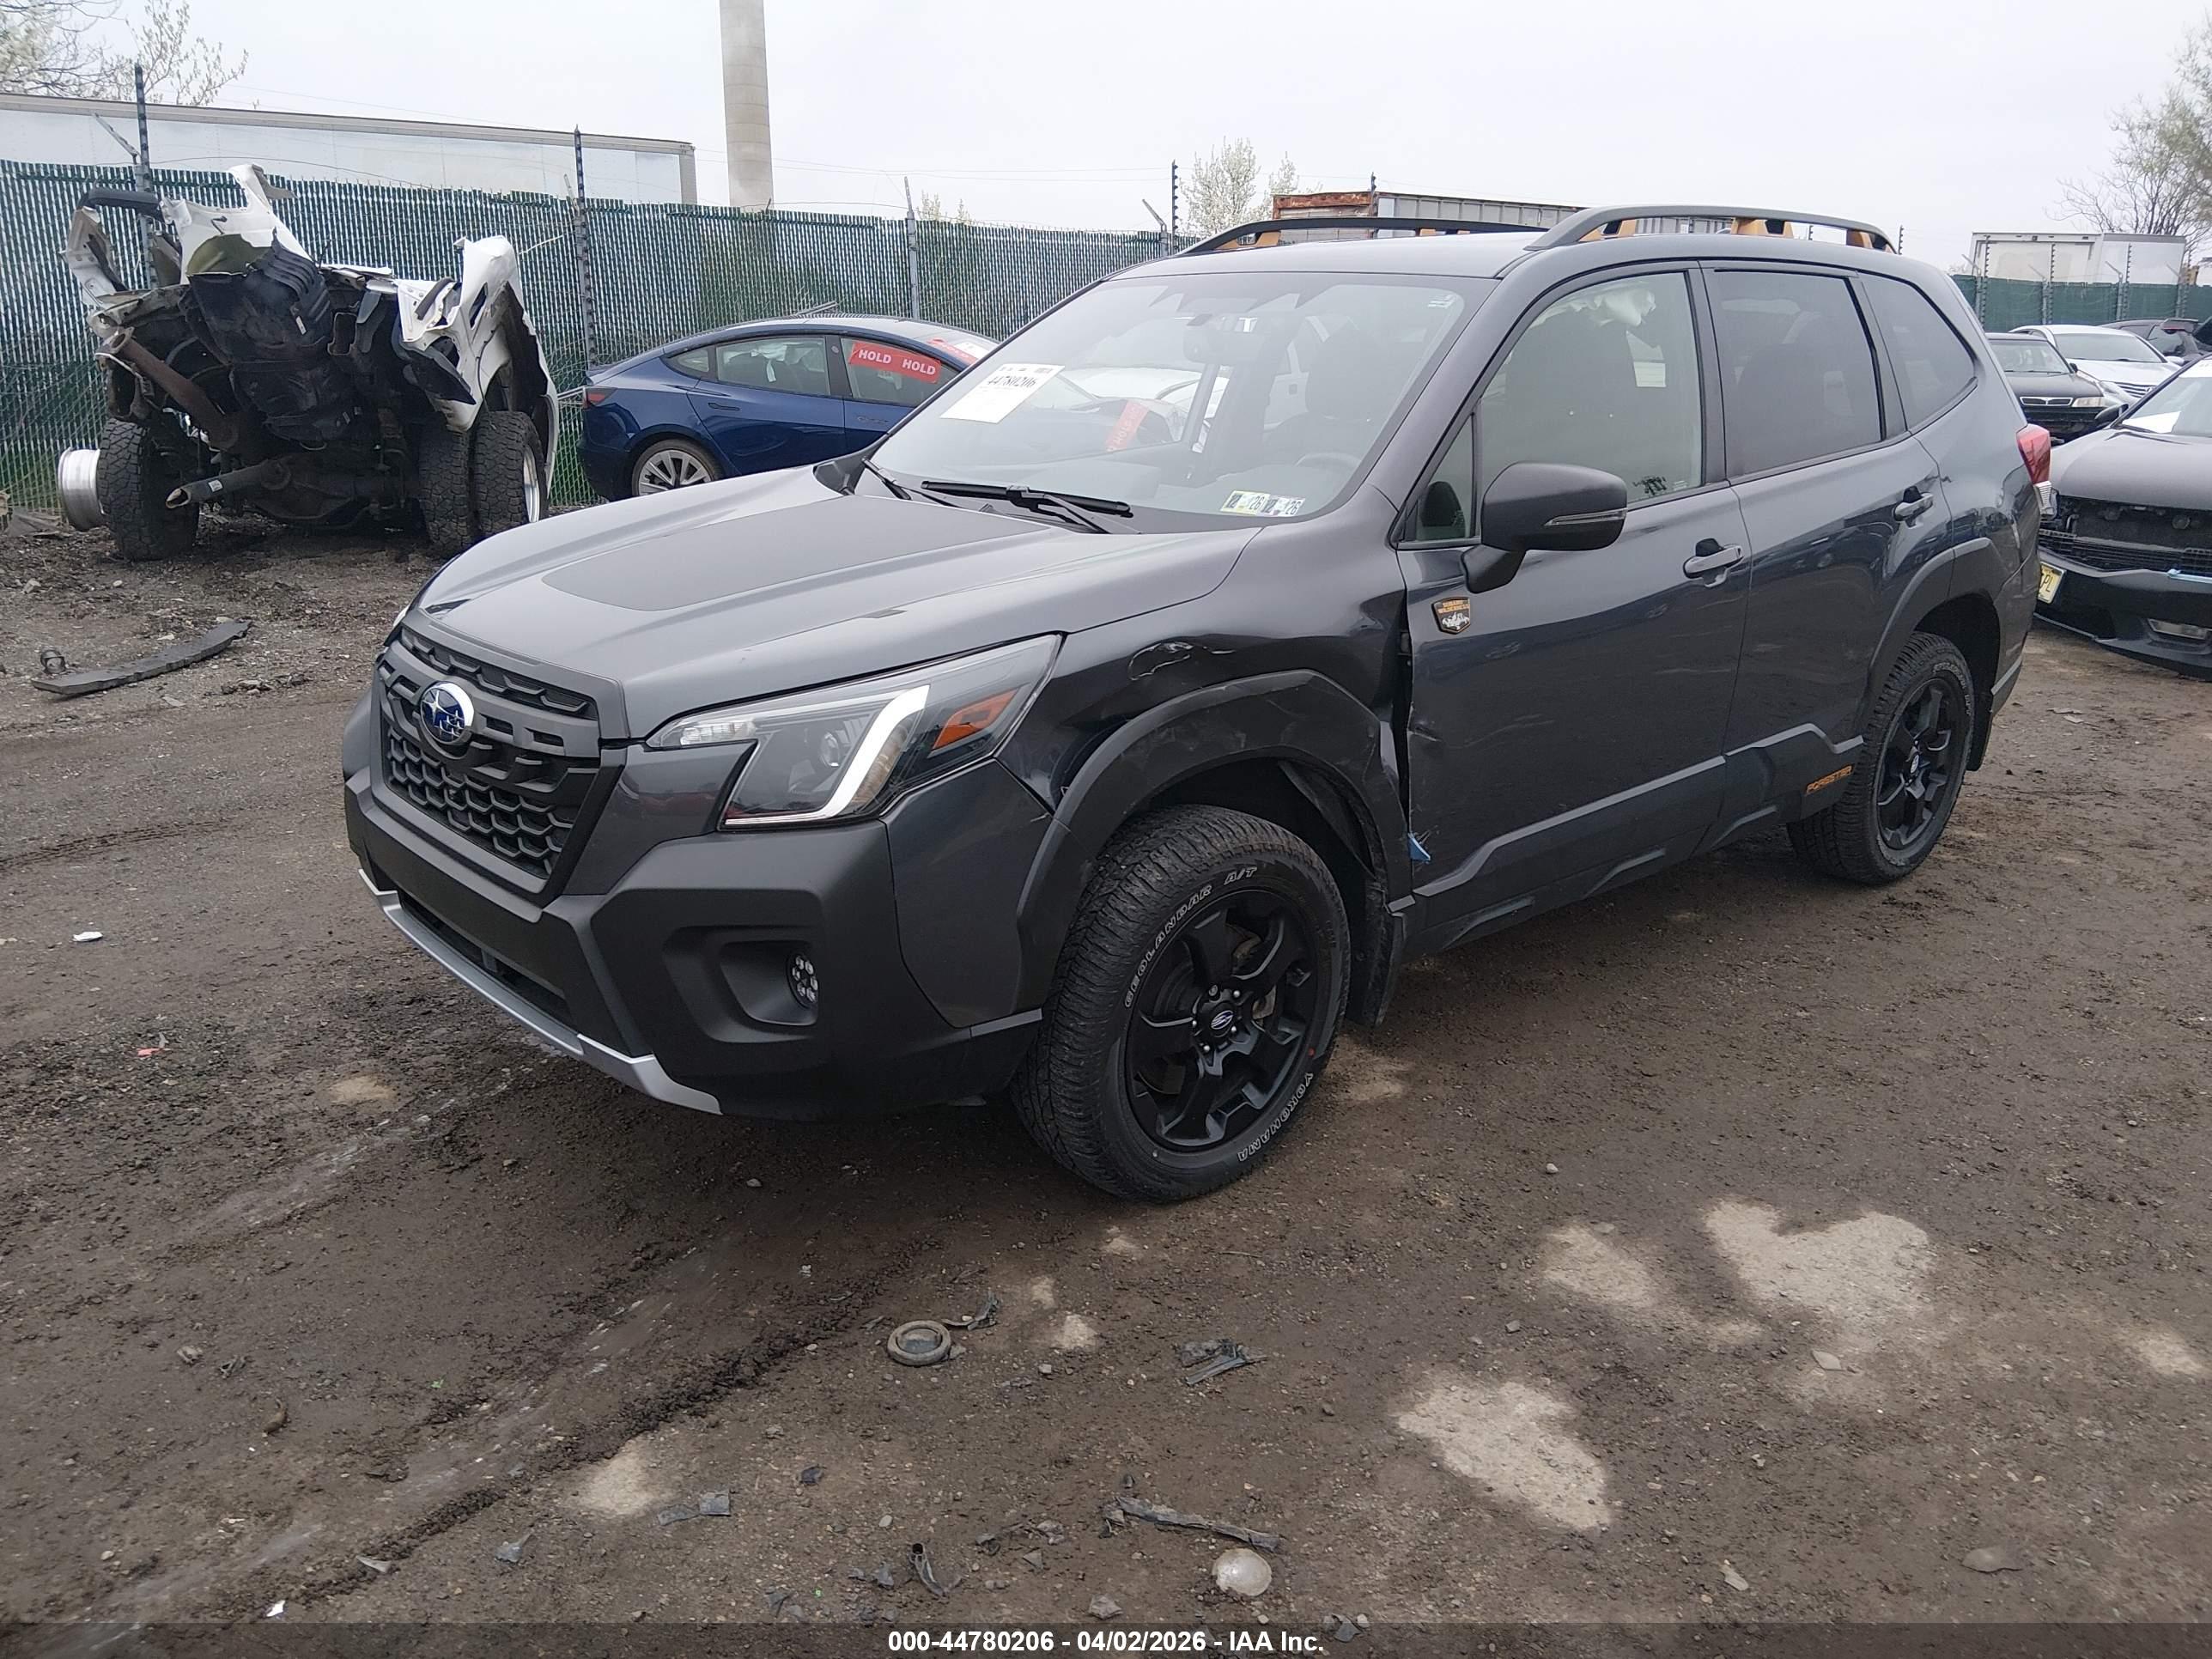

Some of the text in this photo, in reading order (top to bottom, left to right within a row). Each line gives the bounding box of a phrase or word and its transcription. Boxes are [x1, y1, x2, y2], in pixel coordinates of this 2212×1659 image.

[859, 349, 936, 376] HOLD HOLD
[1125, 866, 1258, 1009] GEOLANDAR A/T
[1237, 1073, 1314, 1162] YOKOHAMA
